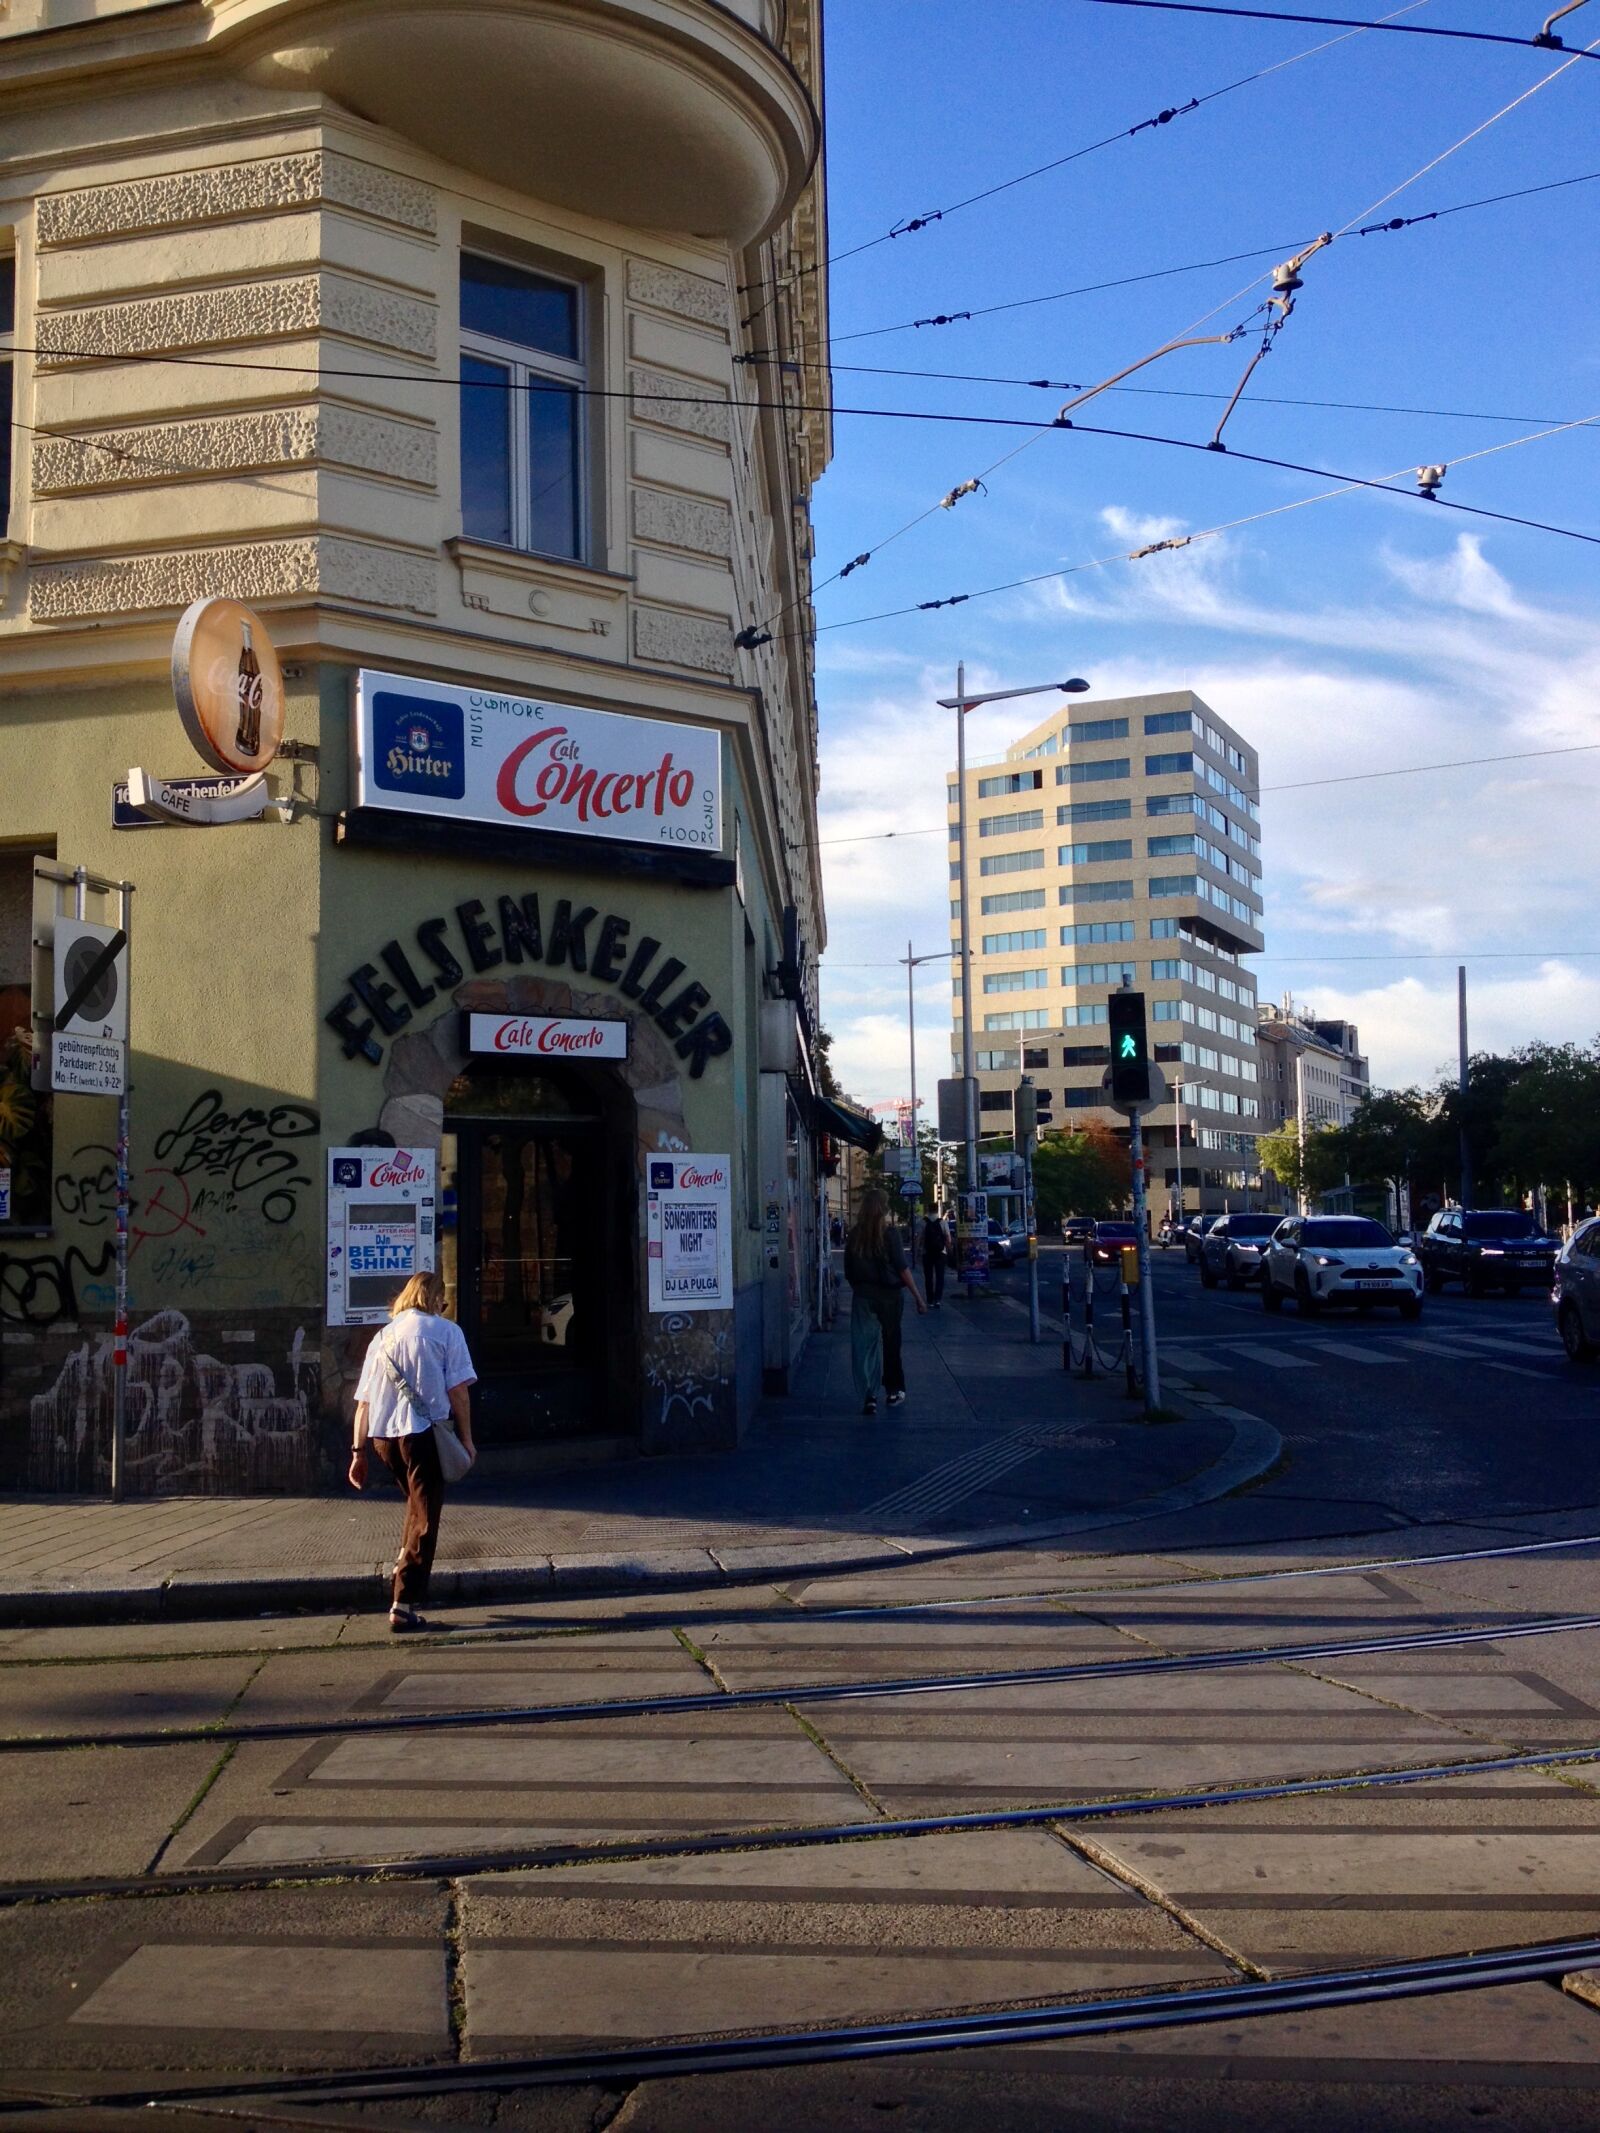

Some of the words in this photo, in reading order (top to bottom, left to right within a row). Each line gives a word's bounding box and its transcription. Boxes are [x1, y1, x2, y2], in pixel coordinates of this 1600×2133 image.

[469, 695, 483, 748] MUSIC
[499, 701, 544, 720] MORE
[549, 738, 580, 762] Cafe
[386, 746, 454, 779] Hirter
[495, 726, 695, 822] Concerto
[161, 790, 191, 813] CAFE
[702, 790, 714, 813] ON
[704, 814, 713, 830] 3
[660, 826, 714, 844] FLOORS
[325, 892, 732, 1080] FELSENKELLER
[494, 1019, 532, 1051] Cafe
[538, 1020, 603, 1052] Concerto
[58, 1041, 119, 1060] gebührenpflichtig
[59, 1056, 97, 1072] Parkdauer:
[99, 1060, 104, 1072] 2
[105, 1061, 118, 1074] Std.
[369, 1162, 425, 1187] Concerto
[679, 1165, 723, 1189] Concerto
[665, 1210, 717, 1230] SONGWRITERS
[348, 1245, 415, 1257] BETTY
[680, 1232, 703, 1253] NIGHT
[350, 1257, 413, 1270] SHINE
[665, 1280, 676, 1291] DJ
[678, 1279, 689, 1291] LA
[691, 1278, 718, 1290] PULGA
